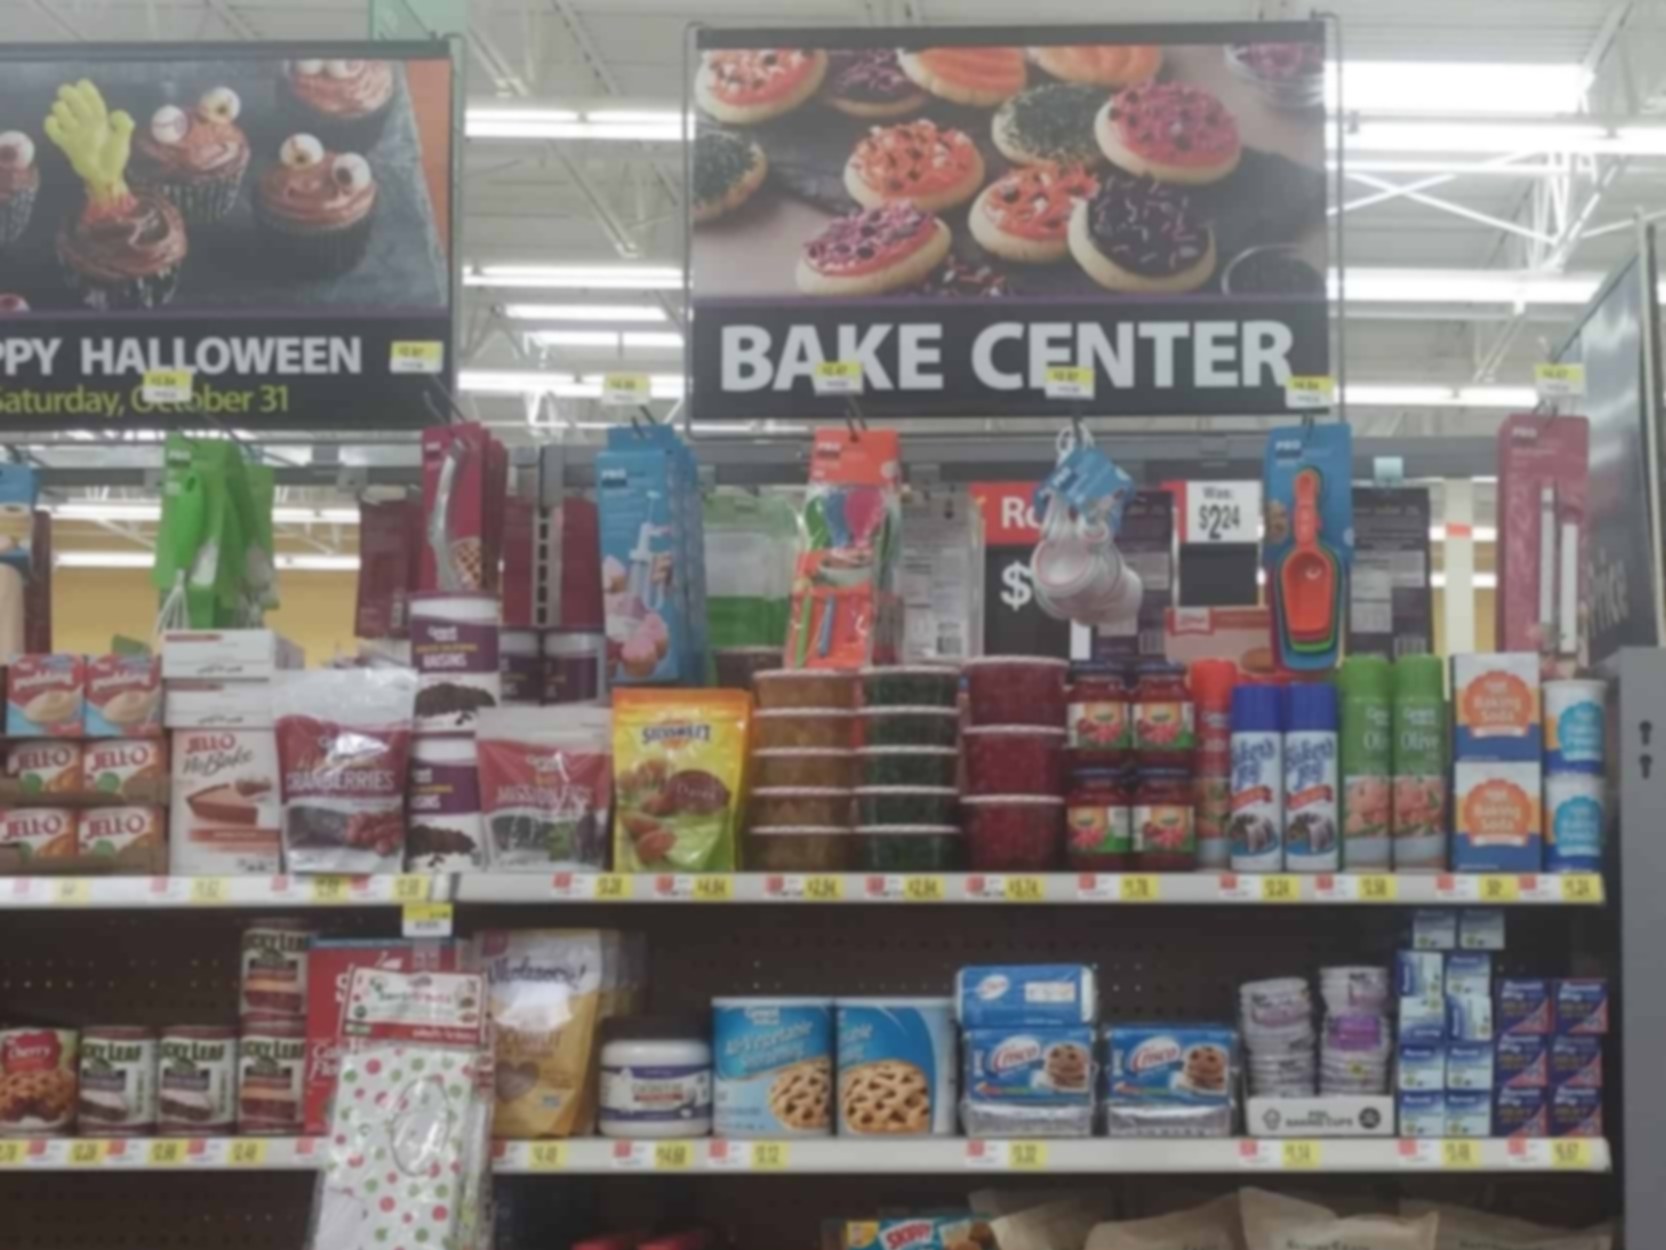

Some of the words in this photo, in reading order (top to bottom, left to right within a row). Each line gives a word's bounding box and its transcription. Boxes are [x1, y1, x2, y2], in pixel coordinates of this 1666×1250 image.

[0, 337, 62, 376] PY
[81, 336, 362, 376] HALLOWEEN
[721, 323, 943, 392] BAKE
[970, 321, 1295, 391] CENTER
[260, 385, 288, 413] 31
[1001, 560, 1033, 612] $
[885, 1222, 934, 1250] SKIPPY
